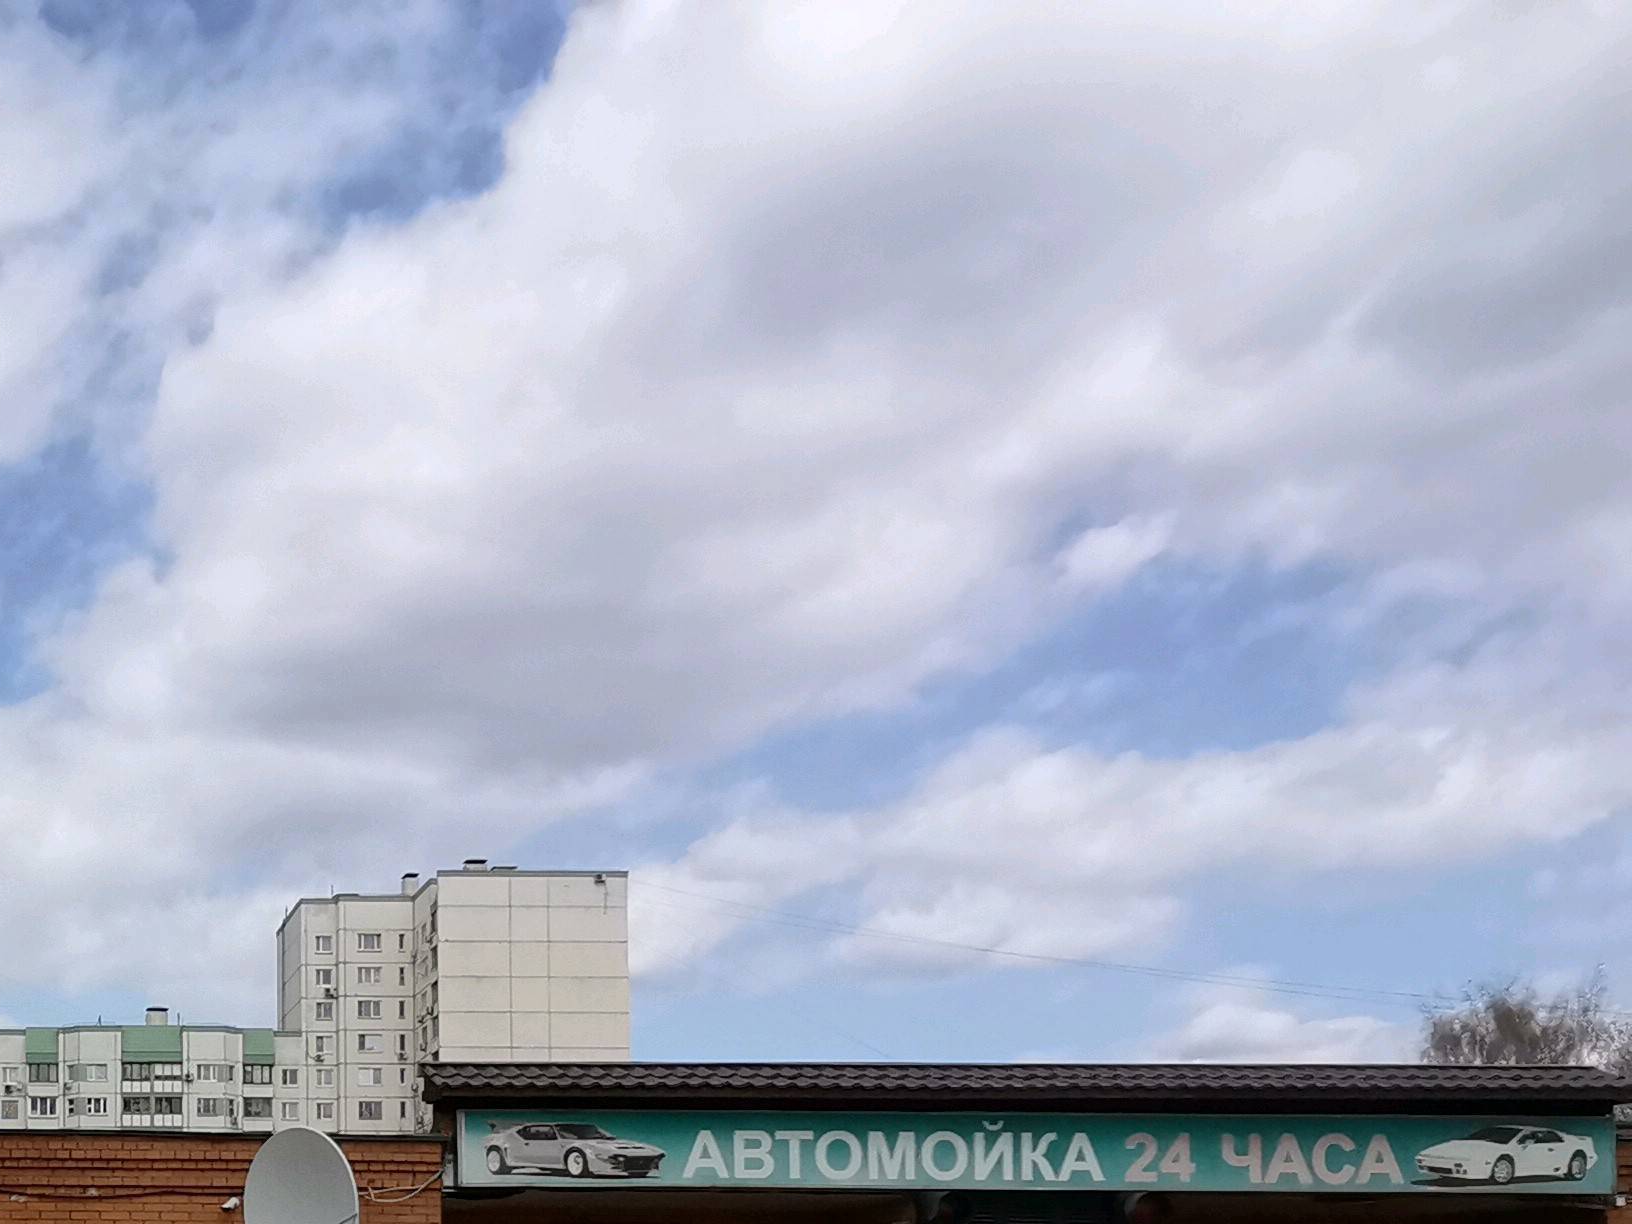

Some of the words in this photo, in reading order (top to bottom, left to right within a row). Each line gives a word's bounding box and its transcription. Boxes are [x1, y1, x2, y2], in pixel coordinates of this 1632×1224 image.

[682, 1119, 1105, 1182] АВТОМОЙКА
[1124, 1132, 1196, 1183] 24
[1221, 1133, 1405, 1186] ЧАСА
